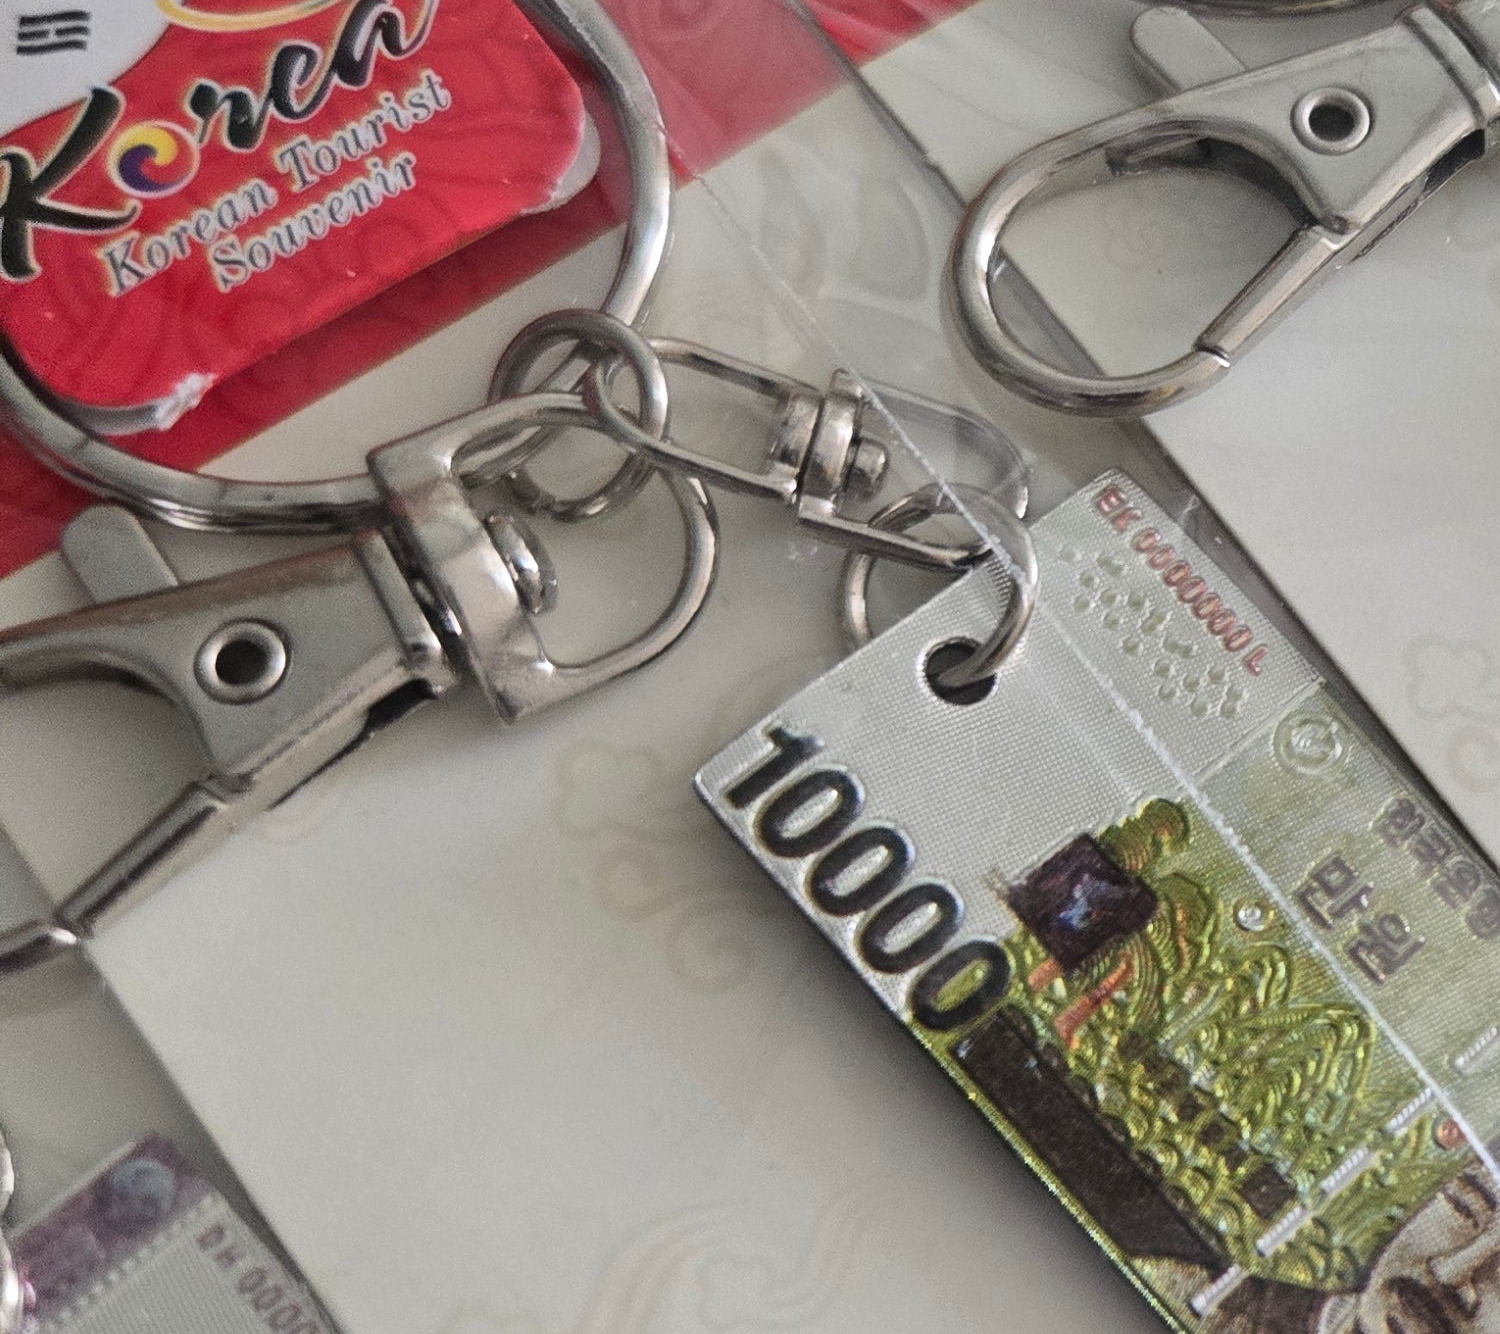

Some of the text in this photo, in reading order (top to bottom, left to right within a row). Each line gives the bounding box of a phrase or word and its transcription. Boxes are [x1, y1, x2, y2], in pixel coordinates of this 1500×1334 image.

[97, 67, 452, 299] Korean Tourist
[208, 151, 418, 293] Souvenir
[719, 719, 1014, 1035] 10000
